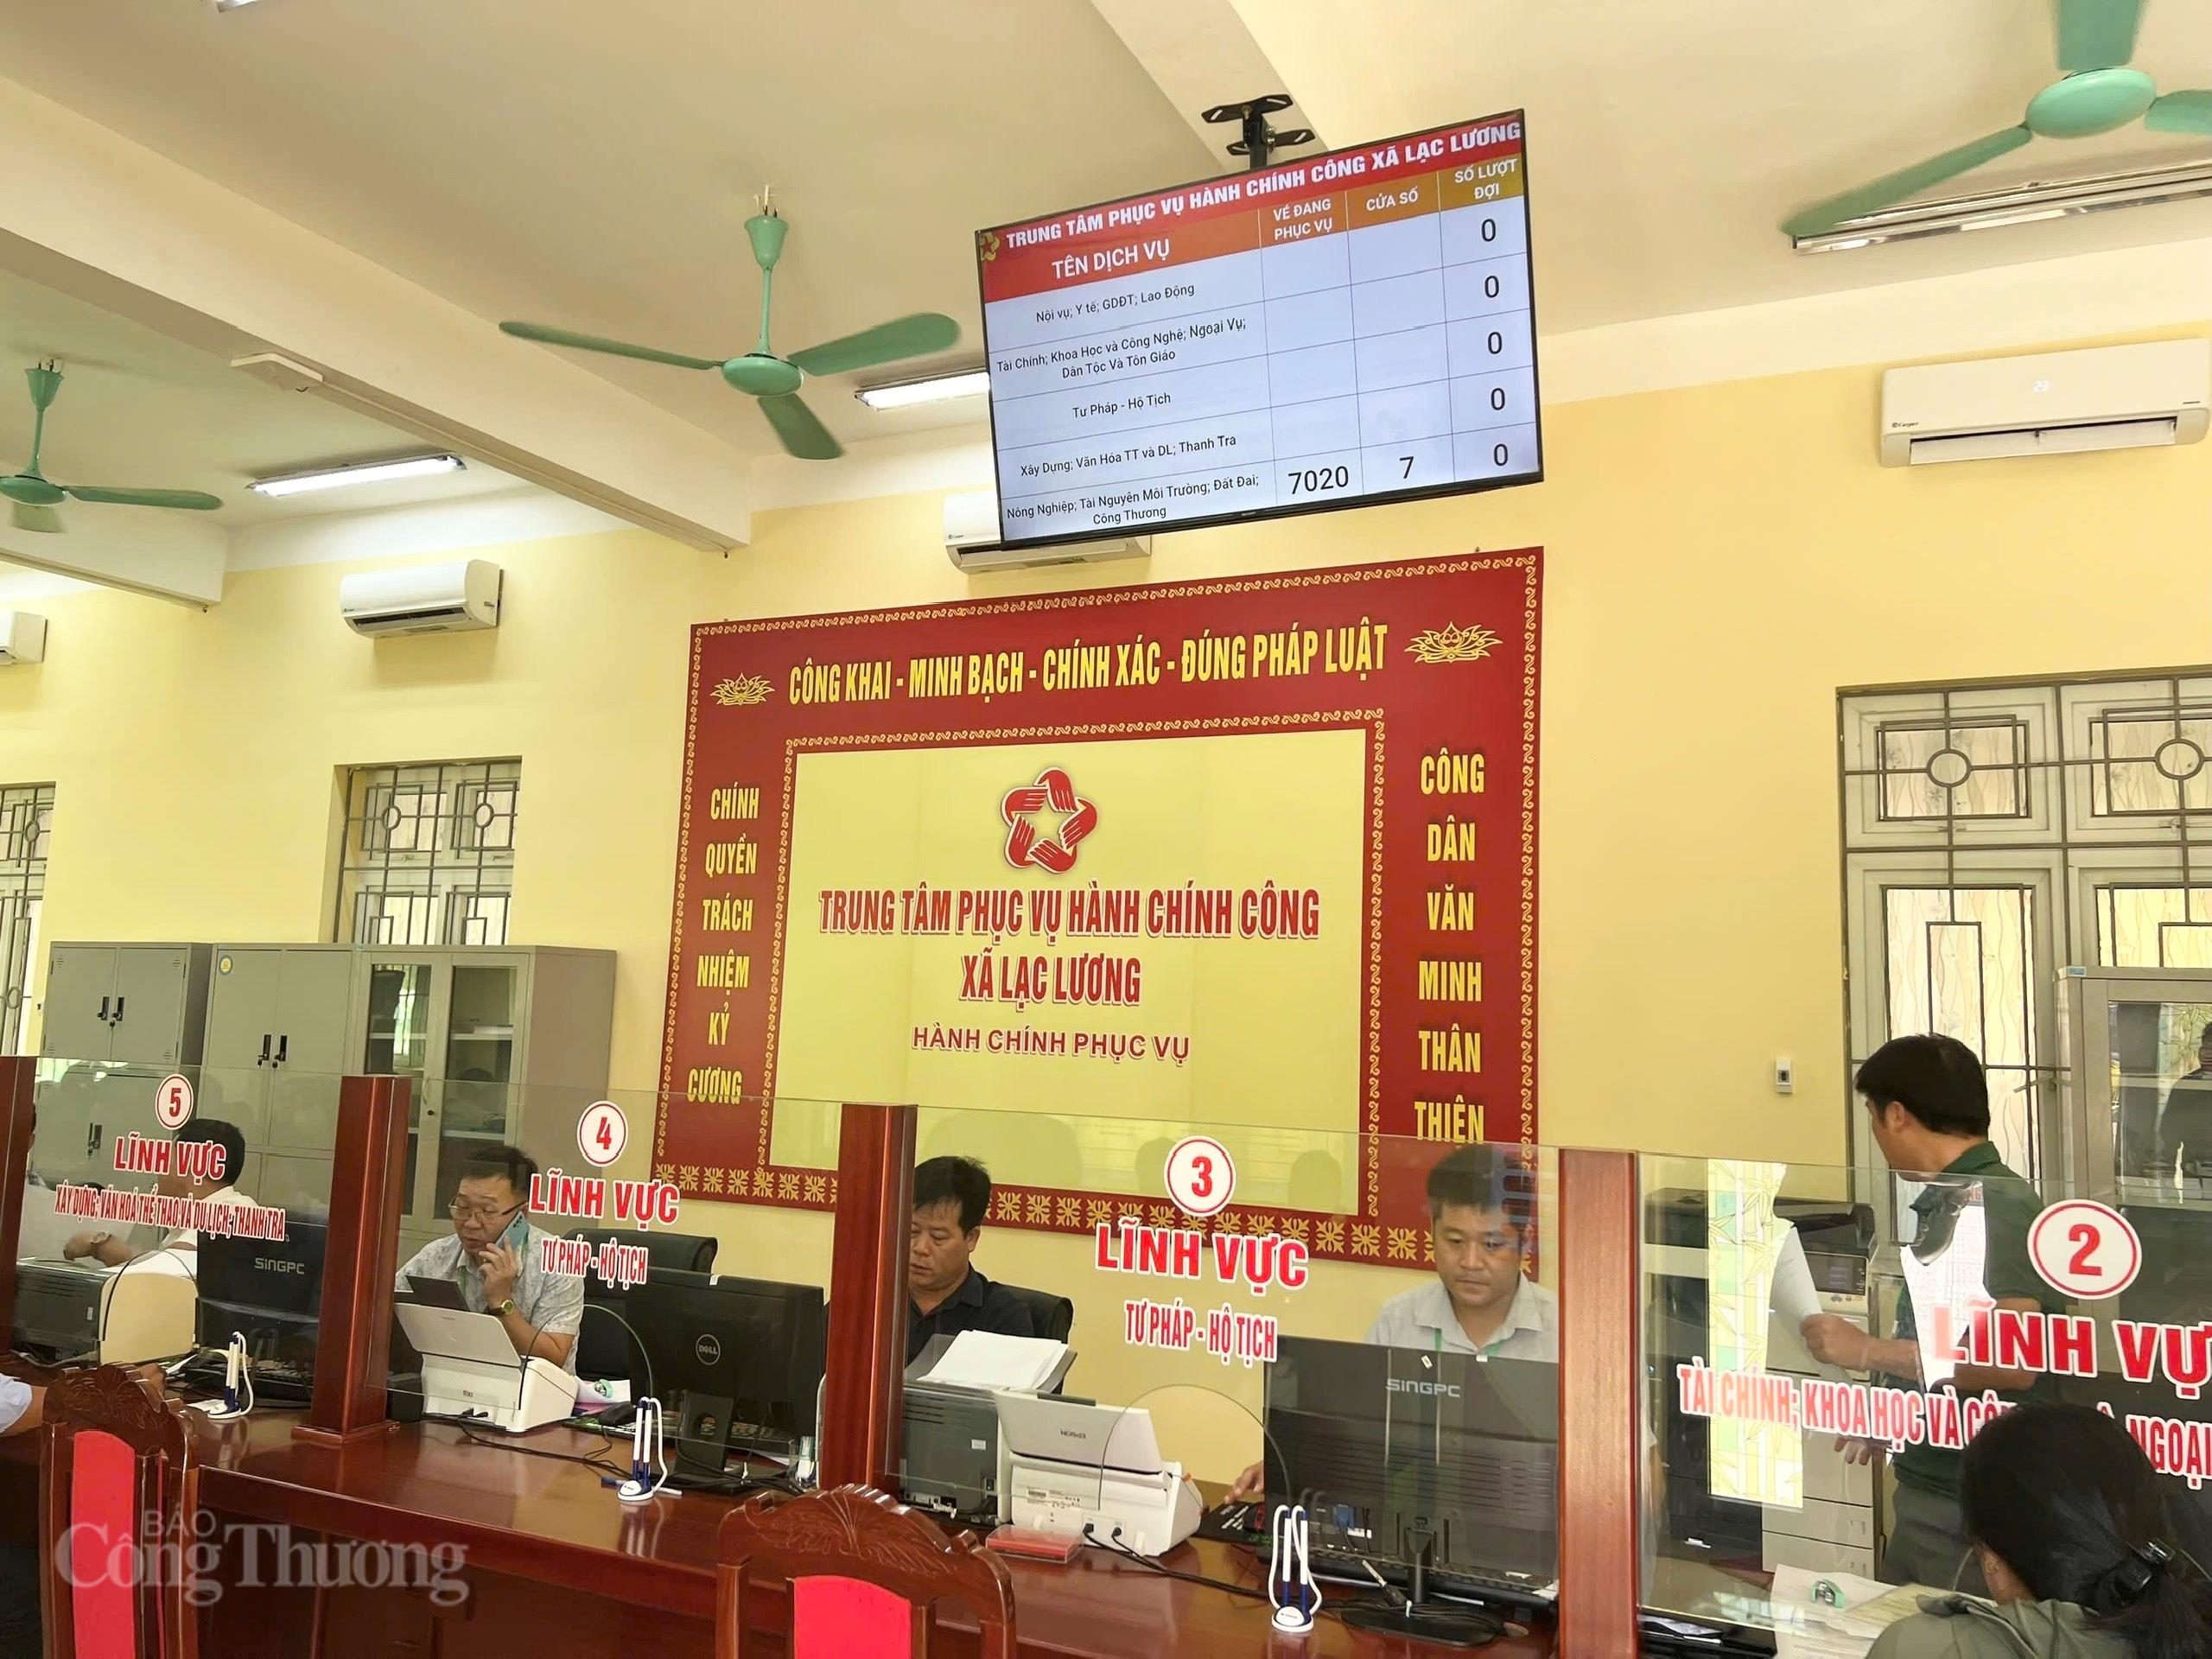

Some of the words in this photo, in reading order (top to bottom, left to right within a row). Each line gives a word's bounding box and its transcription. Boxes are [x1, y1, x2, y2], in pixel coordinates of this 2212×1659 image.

[1007, 224, 1061, 249] TRUNG
[1066, 213, 1103, 235] TÂM
[1109, 202, 1156, 227] PHỤC
[1160, 195, 1184, 215] VỤ
[1189, 180, 1240, 209] HÀNH
[1245, 168, 1305, 197] CHÍNH
[1311, 156, 1365, 183] CÔNG
[1371, 145, 1399, 170] XÃ
[1405, 137, 1444, 163] LẠC
[1451, 121, 1522, 152] LƯƠNG
[1454, 165, 1474, 184] SỐ
[1478, 158, 1518, 178] LƯỢT
[1474, 183, 1500, 200] ĐỢI
[1274, 207, 1291, 221] VÉ
[1294, 198, 1332, 218] ĐANG
[1366, 192, 1395, 212] CỬA
[1399, 186, 1419, 205] SỐ
[1274, 222, 1311, 240] PHỤC
[1314, 218, 1332, 233] VỤ
[1481, 219, 1497, 242] 0
[1052, 254, 1089, 279] TÊN
[1094, 243, 1138, 273] DỊCH
[1143, 238, 1170, 261] VỤ
[1036, 310, 1054, 323] Nội
[1057, 308, 1072, 319] vụ;
[1075, 304, 1084, 315] Y
[1085, 302, 1100, 314] tế;
[1103, 295, 1138, 311] GDĐT;
[1141, 291, 1162, 303] Lao
[1165, 284, 1195, 300] Động
[1484, 276, 1500, 298] 0
[997, 360, 1013, 372] Tài
[1014, 353, 1049, 370] Chính;
[1051, 349, 1077, 363] Khoa
[1081, 345, 1103, 359] Học
[1105, 341, 1118, 353] và
[1122, 335, 1150, 351] Công
[1153, 327, 1186, 345] Nghệ;
[1190, 320, 1224, 339] Ngoại
[1226, 317, 1247, 332] Vụ;
[1487, 332, 1503, 354] 0
[1062, 365, 1084, 378] Dân
[1085, 361, 1106, 374] Tộc
[1109, 359, 1124, 370] Và
[1126, 354, 1147, 367] Tôn
[1150, 350, 1176, 363] Giáo
[1072, 407, 1087, 418] Tư
[1090, 401, 1118, 416] Pháp
[1128, 397, 1144, 410] Hộ
[1147, 392, 1171, 406] Tịch
[1491, 388, 1505, 410] 0
[1020, 464, 1039, 477] Xây
[1043, 460, 1074, 474] Dựng;
[1076, 455, 1096, 468] Văn
[1099, 451, 1122, 465] Hóa
[1124, 448, 1140, 461] TT
[1142, 446, 1156, 458] và
[1158, 443, 1176, 457] DL;
[1179, 437, 1215, 453] Thanh
[1217, 435, 1236, 448] Tra
[1399, 455, 1414, 479] 7
[1493, 443, 1509, 466] 0
[1007, 505, 1034, 519] Nông
[1037, 499, 1077, 517] Nghiệp;
[1079, 496, 1096, 509] Tài
[1098, 490, 1140, 508] Nguyên
[1142, 486, 1164, 501] Môi
[1166, 480, 1211, 499] Trường;
[1214, 477, 1234, 491] Đất
[1236, 474, 1259, 487] Đai;
[1288, 465, 1349, 495] 7020
[1093, 511, 1122, 525] Công
[1123, 506, 1166, 522] Thương
[789, 658, 841, 705] CÔNG
[845, 661, 892, 702] KHAI
[908, 656, 963, 698] MINH
[968, 652, 1025, 703] BẠCH
[1042, 639, 1110, 691] CHÍNH
[1116, 634, 1161, 686] XÁC
[1181, 629, 1246, 683] ĐÚNG
[1252, 622, 1319, 677] PHÁP
[1325, 616, 1388, 681] LUẬT
[1421, 747, 1485, 794] CÔNG
[710, 782, 760, 820] CHÍNH
[705, 832, 758, 877] QUYỀN
[1427, 815, 1476, 861] DÂN
[702, 893, 753, 931] TRÁCH
[820, 889, 895, 933] TRUNG
[902, 882, 950, 933] TÂM
[957, 889, 1022, 944] PHỤC
[1032, 889, 1061, 944] VỤ
[1070, 881, 1140, 937] HÀNH
[1147, 880, 1233, 938] CHÍNH
[1240, 880, 1319, 938] CÔNG
[1427, 884, 1474, 931] VĂN
[696, 950, 750, 995] NHIỆM
[960, 947, 994, 1001] XÃ
[1001, 956, 1047, 1010] LẠC
[1054, 952, 1141, 1005] LƯƠNG
[1419, 960, 1482, 1001] MINH
[709, 1001, 730, 1046] KỶ
[913, 1022, 980, 1051] HÀNH
[988, 1027, 1065, 1055] CHÍNH
[1072, 1034, 1147, 1062] PHỤC
[1154, 1036, 1190, 1065] VỤ
[1419, 1023, 1481, 1072] THÂN
[168, 1087, 181, 1117] 5
[687, 1067, 742, 1104] CƯƠNG
[596, 1117, 612, 1149] 4
[115, 1133, 169, 1173] LĨNH
[177, 1140, 226, 1183] VỰC
[1192, 1156, 1213, 1197] 3
[156, 1196, 179, 1228] THAO
[181, 1193, 193, 1229] VÀ
[193, 1201, 207, 1231] DU
[233, 1205, 265, 1238] THANH
[265, 1208, 285, 1241] TRA
[531, 1170, 605, 1217] LĨNH
[614, 1180, 679, 1230] VỰC
[543, 1239, 558, 1274] TƯ
[559, 1236, 589, 1275] PHÁP
[600, 1239, 617, 1287] HỘ
[618, 1246, 647, 1288] TỊCH
[1096, 1219, 1200, 1277] LĨNH
[1214, 1236, 1306, 1294] VỰC
[2068, 1224, 2103, 1276] 2
[1126, 1301, 1147, 1343] TƯ
[1149, 1300, 1193, 1348] PHÁP
[1210, 1306, 1231, 1363] HỘ
[1236, 1316, 1275, 1365] TỊCH
[1933, 1299, 2095, 1374] LĨNH
[2117, 1320, 2212, 1396] VỰ
[1681, 1359, 1713, 1413] TÀI
[1721, 1368, 1798, 1430] CHÍNH;
[1805, 1382, 1867, 1434] KHOA
[1874, 1389, 1922, 1450] HỌC
[1928, 1389, 1960, 1446] VÀ
